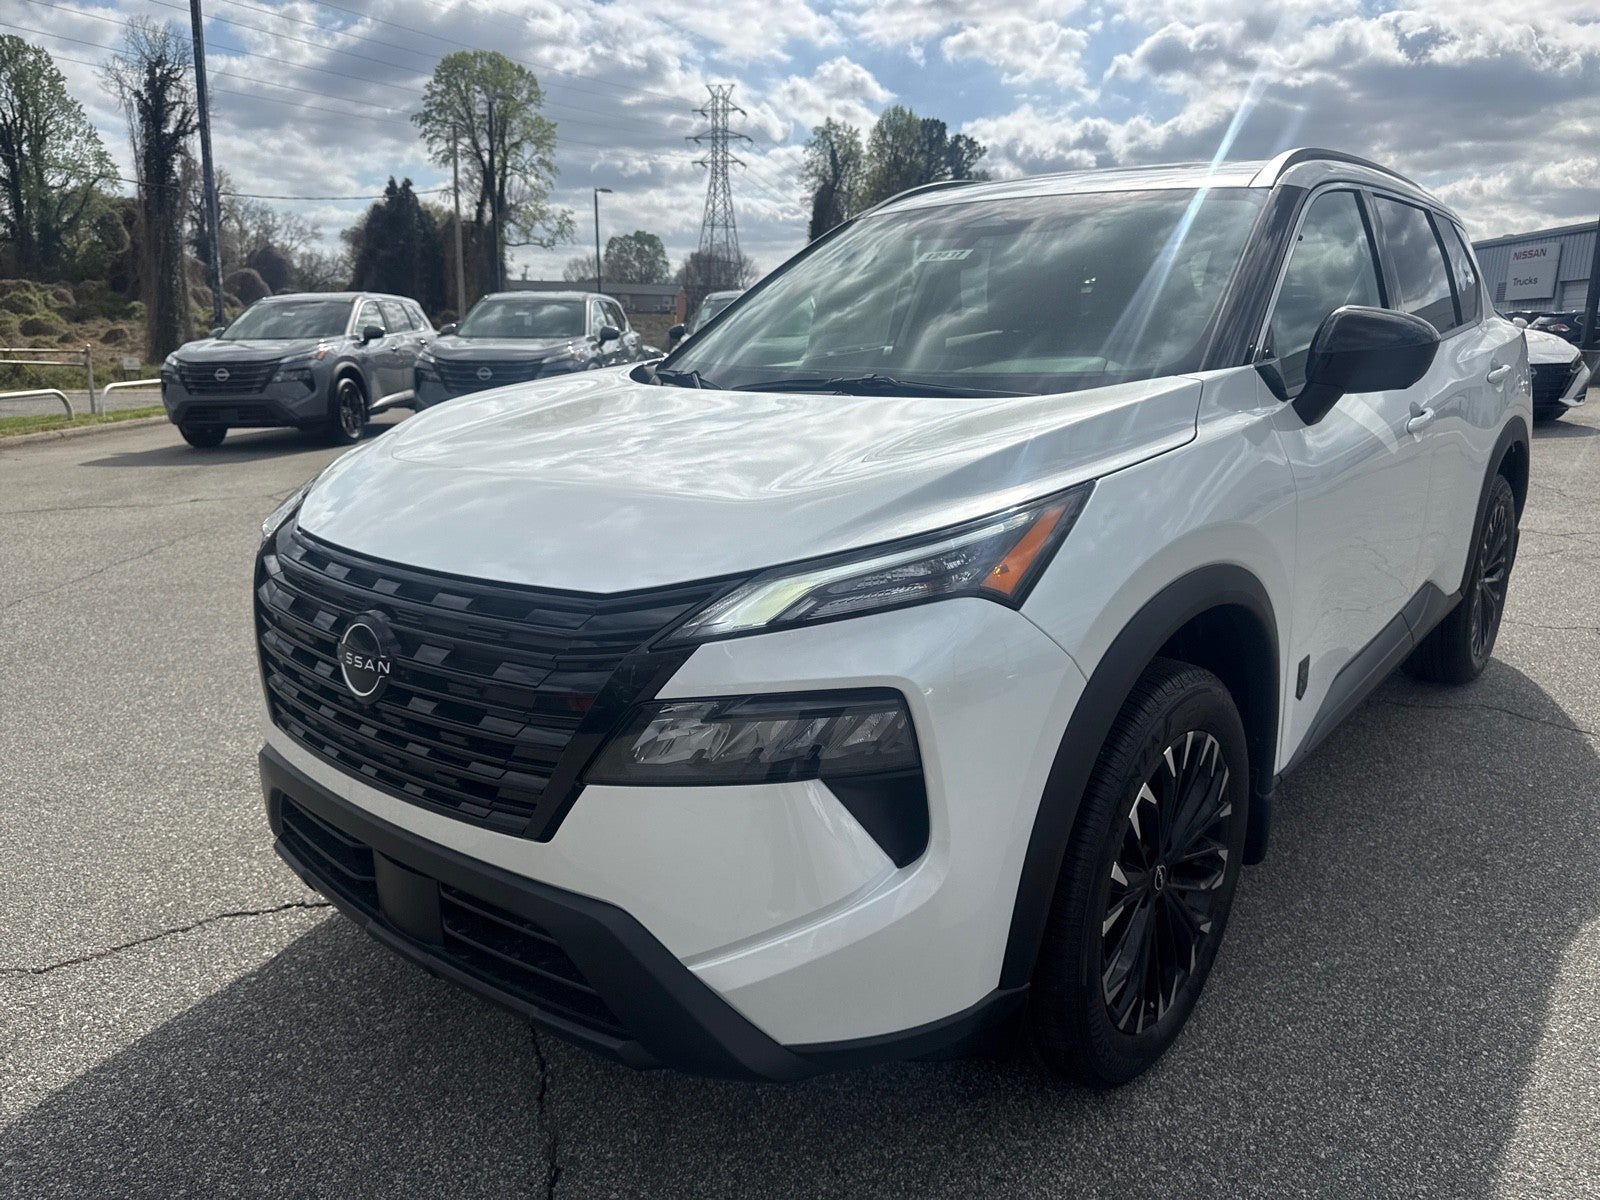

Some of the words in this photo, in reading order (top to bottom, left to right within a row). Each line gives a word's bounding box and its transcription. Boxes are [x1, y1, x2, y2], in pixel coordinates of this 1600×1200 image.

[1513, 248, 1547, 260] NISSAN
[1513, 276, 1538, 286] Trucks
[343, 651, 391, 674] SSAN
